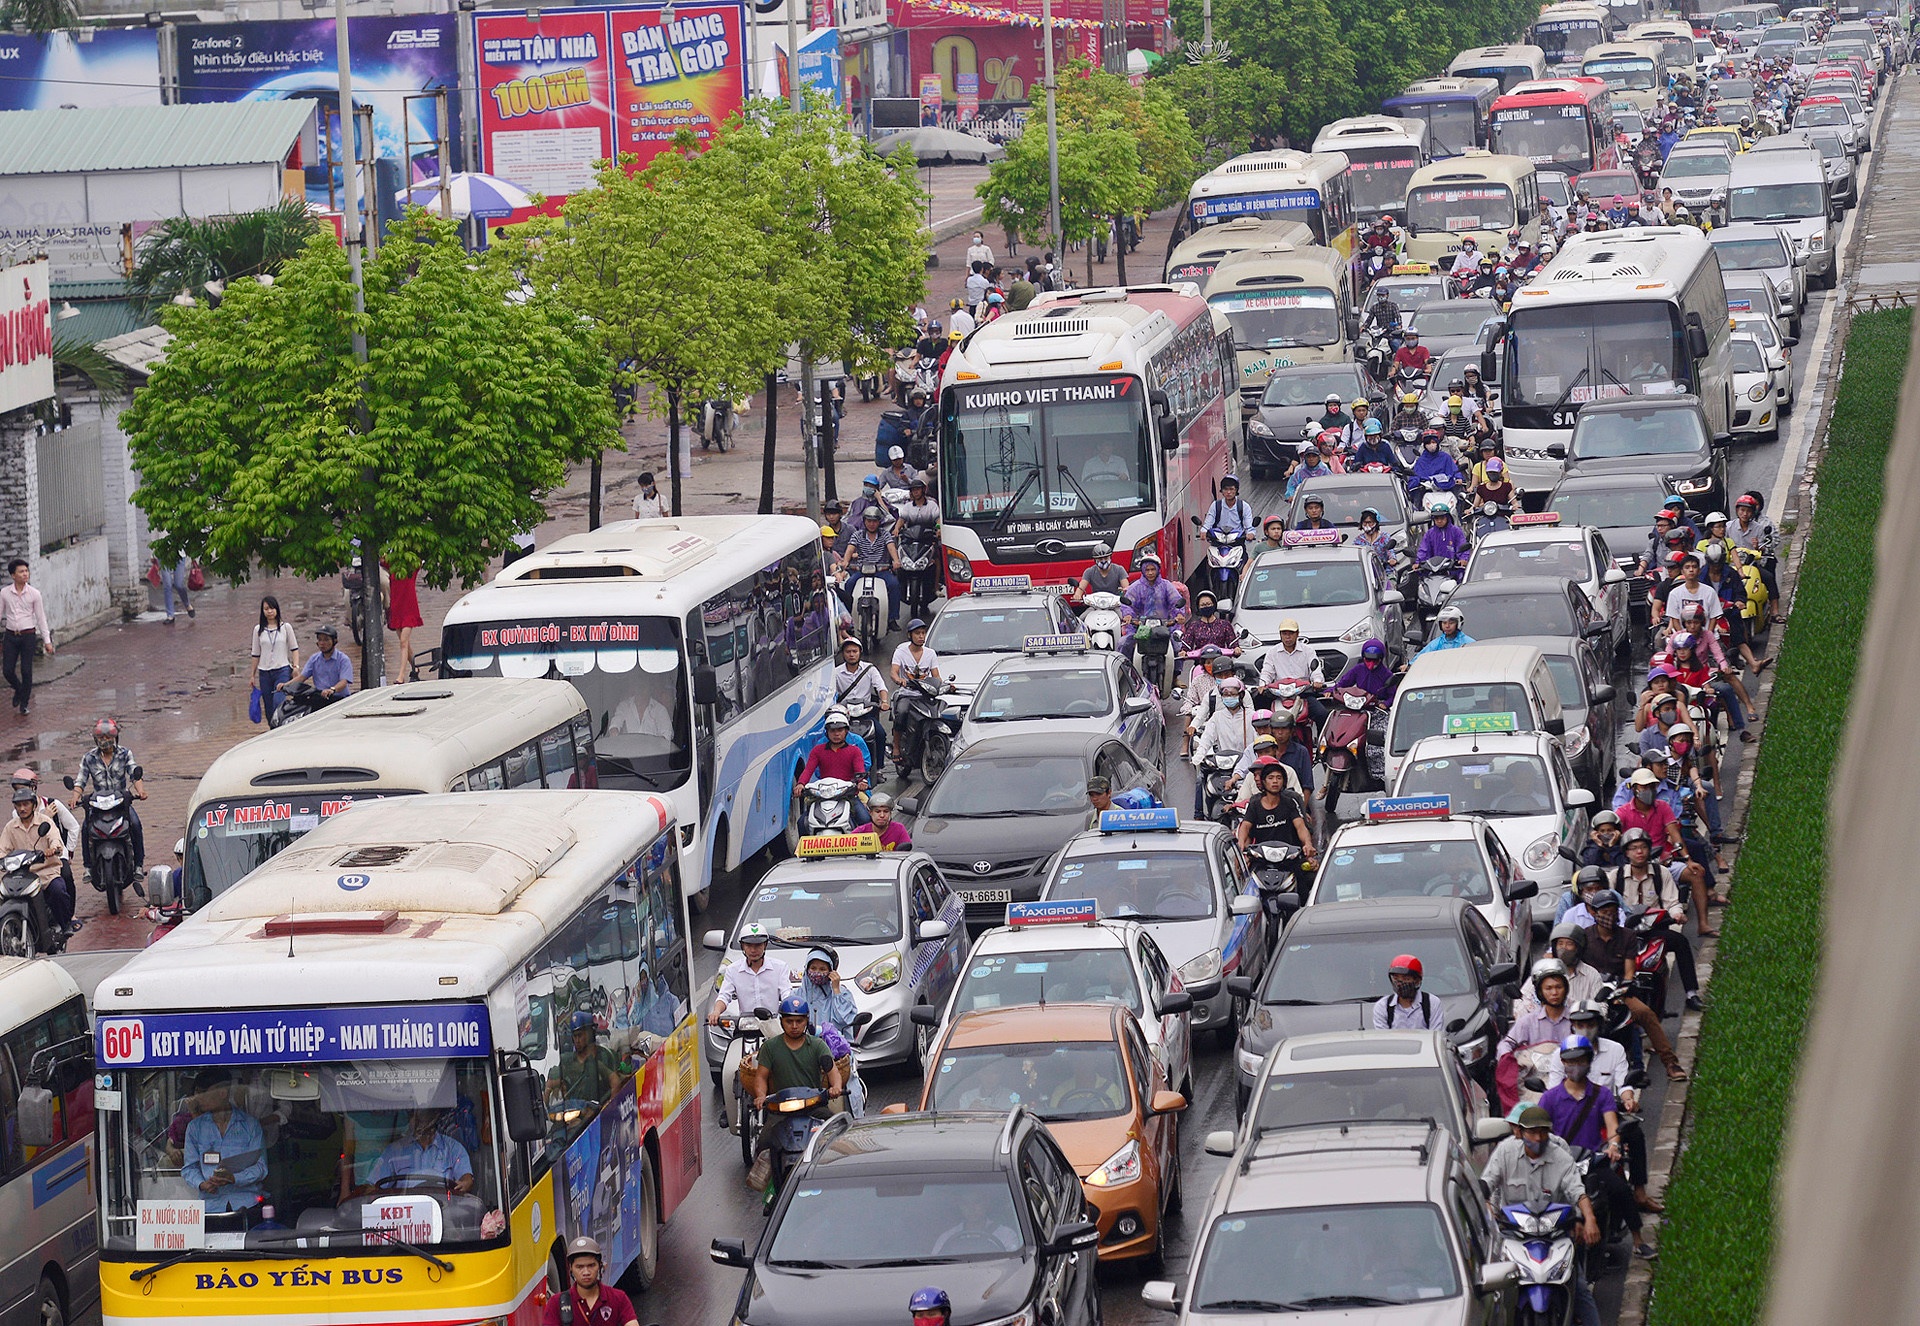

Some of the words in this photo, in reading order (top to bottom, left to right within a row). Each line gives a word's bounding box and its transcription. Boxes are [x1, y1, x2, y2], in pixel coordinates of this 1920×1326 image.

[387, 28, 440, 43] ASUS
[622, 25, 664, 55] BÁN
[667, 13, 725, 46] HÀNG
[192, 38, 232, 49] Zenfone
[235, 37, 242, 48] 2
[522, 36, 556, 63] TẬN
[560, 33, 597, 59] NHÀ
[193, 54, 220, 66] Nhìn
[221, 52, 246, 67] thấy
[248, 50, 272, 64] điều
[274, 49, 300, 63] khác
[302, 48, 323, 63] biệt
[627, 46, 676, 84] TRẢ
[679, 40, 729, 74] GÓP
[494, 77, 547, 117] 100
[547, 78, 589, 107] KM
[16, 226, 40, 239] NHÀ
[73, 226, 112, 237] TRANG
[69, 252, 89, 260] KHU
[92, 251, 99, 260] B
[1181, 265, 1204, 277] YÊN
[1245, 298, 1254, 308] XE
[1273, 296, 1286, 307] CAO
[1244, 359, 1268, 378] NAM
[966, 390, 1021, 408] KUMHO
[1025, 388, 1058, 404] VIET
[1063, 385, 1115, 401] THANH
[960, 497, 979, 512] MỸ
[1051, 497, 1076, 507] SDV
[1017, 522, 1032, 533] ĐÌNH
[1045, 519, 1062, 531] CHÁY
[976, 579, 990, 587] SAO
[992, 577, 1016, 587] HANOI
[482, 630, 498, 646] BX
[500, 624, 539, 646] QUỲNH
[540, 623, 560, 643] CÔI
[570, 625, 587, 642] BX
[589, 622, 608, 641] MỸ
[609, 622, 639, 641] ĐÌNH
[1028, 637, 1043, 646] SAO
[1045, 636, 1070, 646] HANOI
[207, 804, 228, 827] LÝ
[235, 800, 291, 823] NHÂN
[1380, 801, 1447, 812] TAXIGROUP
[1129, 812, 1155, 821] SAO
[1020, 905, 1093, 916] TAXIGROUP
[105, 1023, 142, 1059] 60A
[151, 1031, 180, 1057] KĐT
[184, 1025, 226, 1056] PHÁP
[229, 1024, 262, 1054] VÂN
[266, 1020, 287, 1053] TỨ
[289, 1021, 325, 1057] HIỆP
[340, 1025, 377, 1050] NAM
[381, 1018, 434, 1050] THĂNG
[438, 1021, 479, 1047] LONG
[155, 1206, 176, 1225] NƯỚC
[177, 1206, 200, 1225] NGẦM
[381, 1206, 413, 1220] KĐT
[154, 1232, 166, 1250] MỸ
[167, 1231, 185, 1250] ĐÌNH
[195, 1267, 259, 1290] BẢO
[268, 1263, 331, 1287] YẾN
[342, 1268, 403, 1285] BUS
